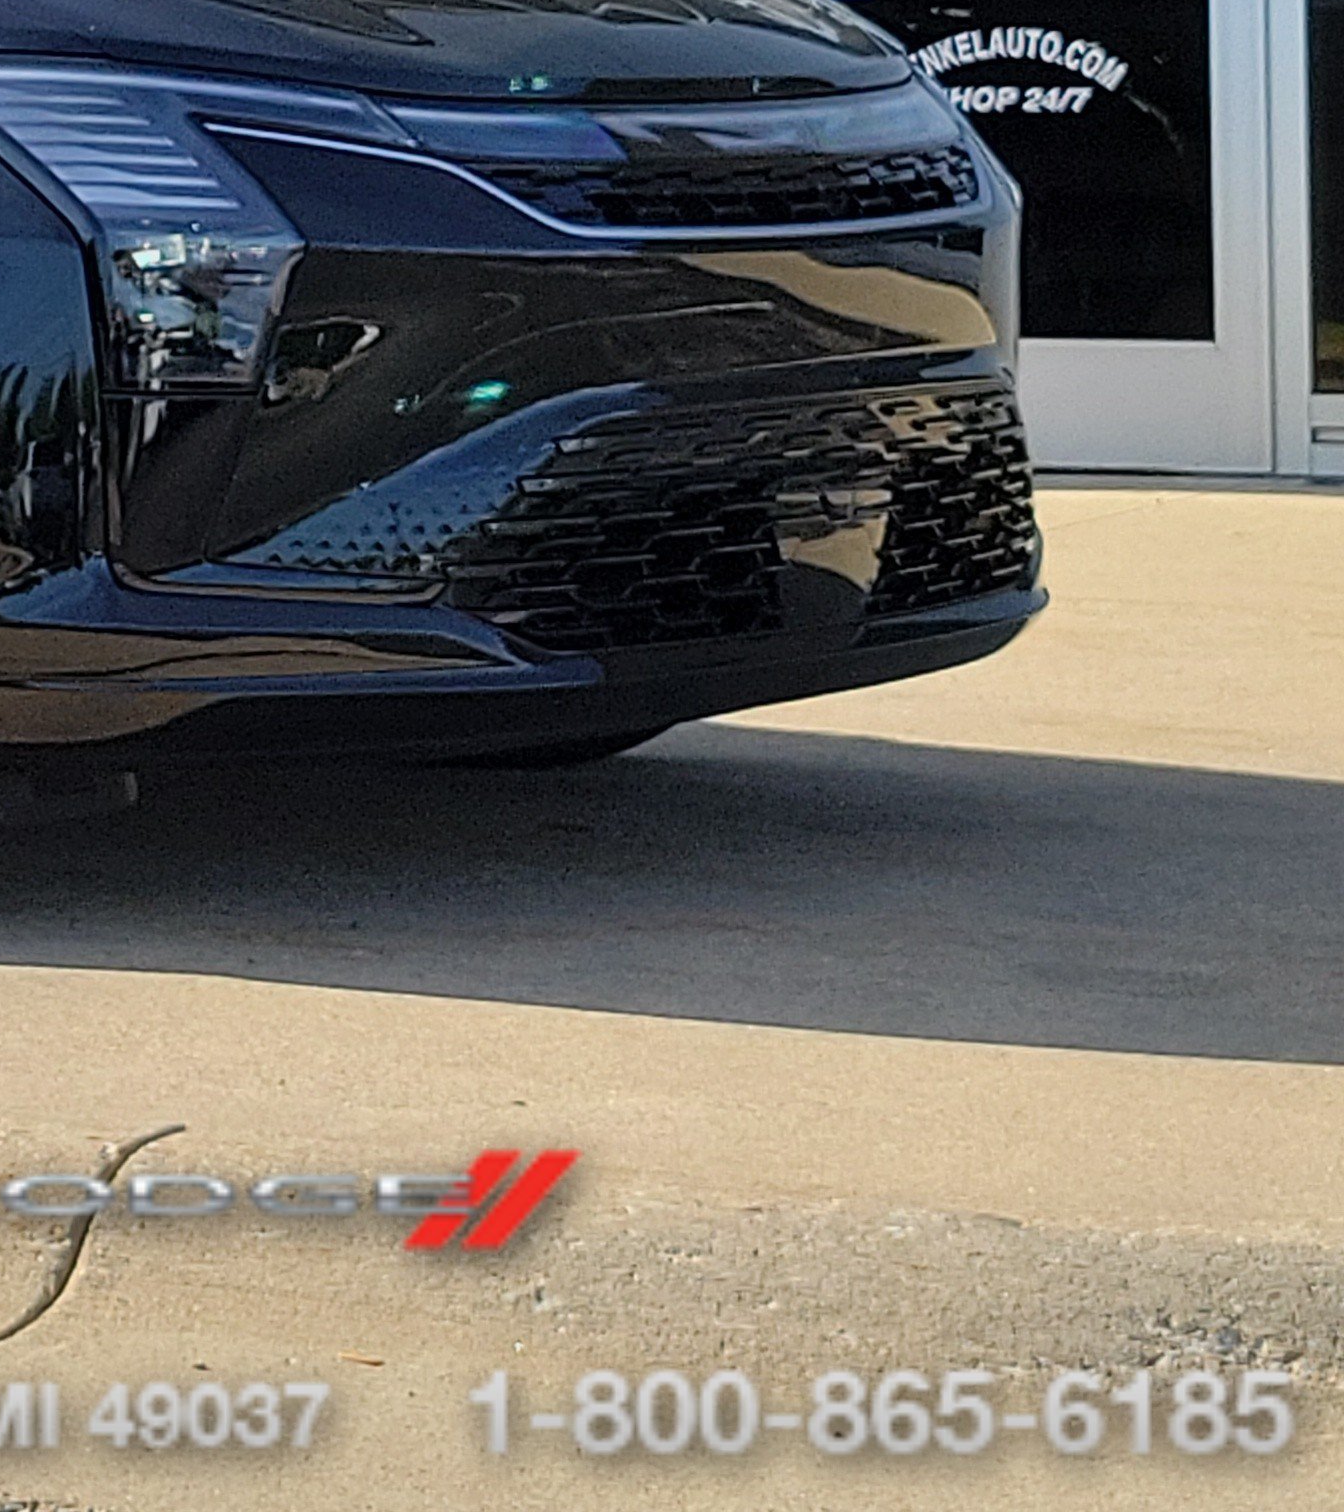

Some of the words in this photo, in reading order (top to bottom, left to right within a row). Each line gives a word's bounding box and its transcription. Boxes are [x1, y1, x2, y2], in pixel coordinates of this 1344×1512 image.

[909, 26, 1129, 92] NKELAUTO.COM
[946, 86, 1020, 114] HOP
[1022, 86, 1094, 114] 24/7
